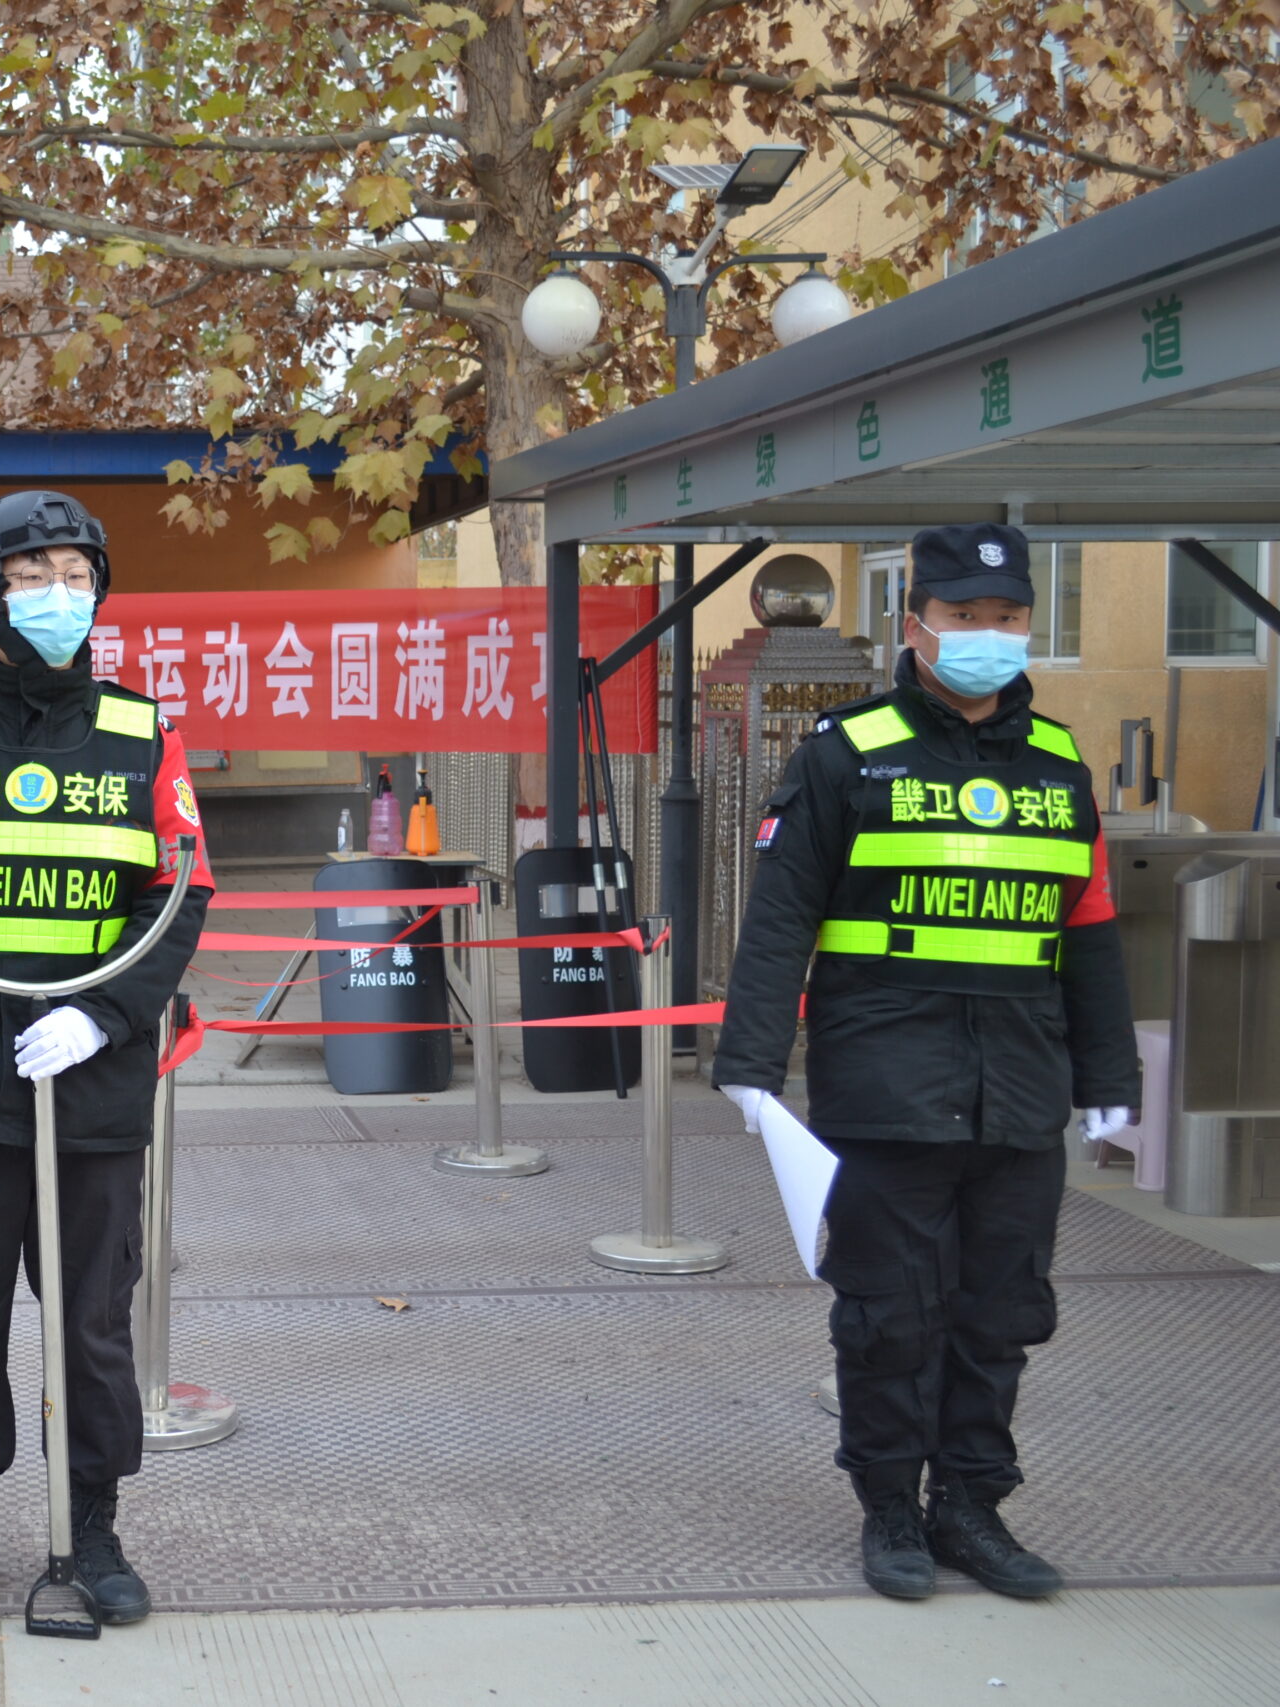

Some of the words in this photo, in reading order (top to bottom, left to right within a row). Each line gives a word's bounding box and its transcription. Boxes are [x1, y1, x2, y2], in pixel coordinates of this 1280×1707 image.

[612, 294, 1184, 521] 师生绿色通道
[62, 771, 129, 816] 安保
[1011, 786, 1074, 829] 安保
[16, 867, 58, 908] AN
[65, 869, 117, 910] BAO
[890, 875, 916, 914] JI
[923, 876, 976, 918] WEI
[980, 879, 1017, 920] AN
[1020, 882, 1059, 923] BAO
[350, 971, 386, 987] FANG
[389, 971, 416, 986] BAO
[553, 967, 587, 982] FANG
[588, 966, 605, 981] BA
